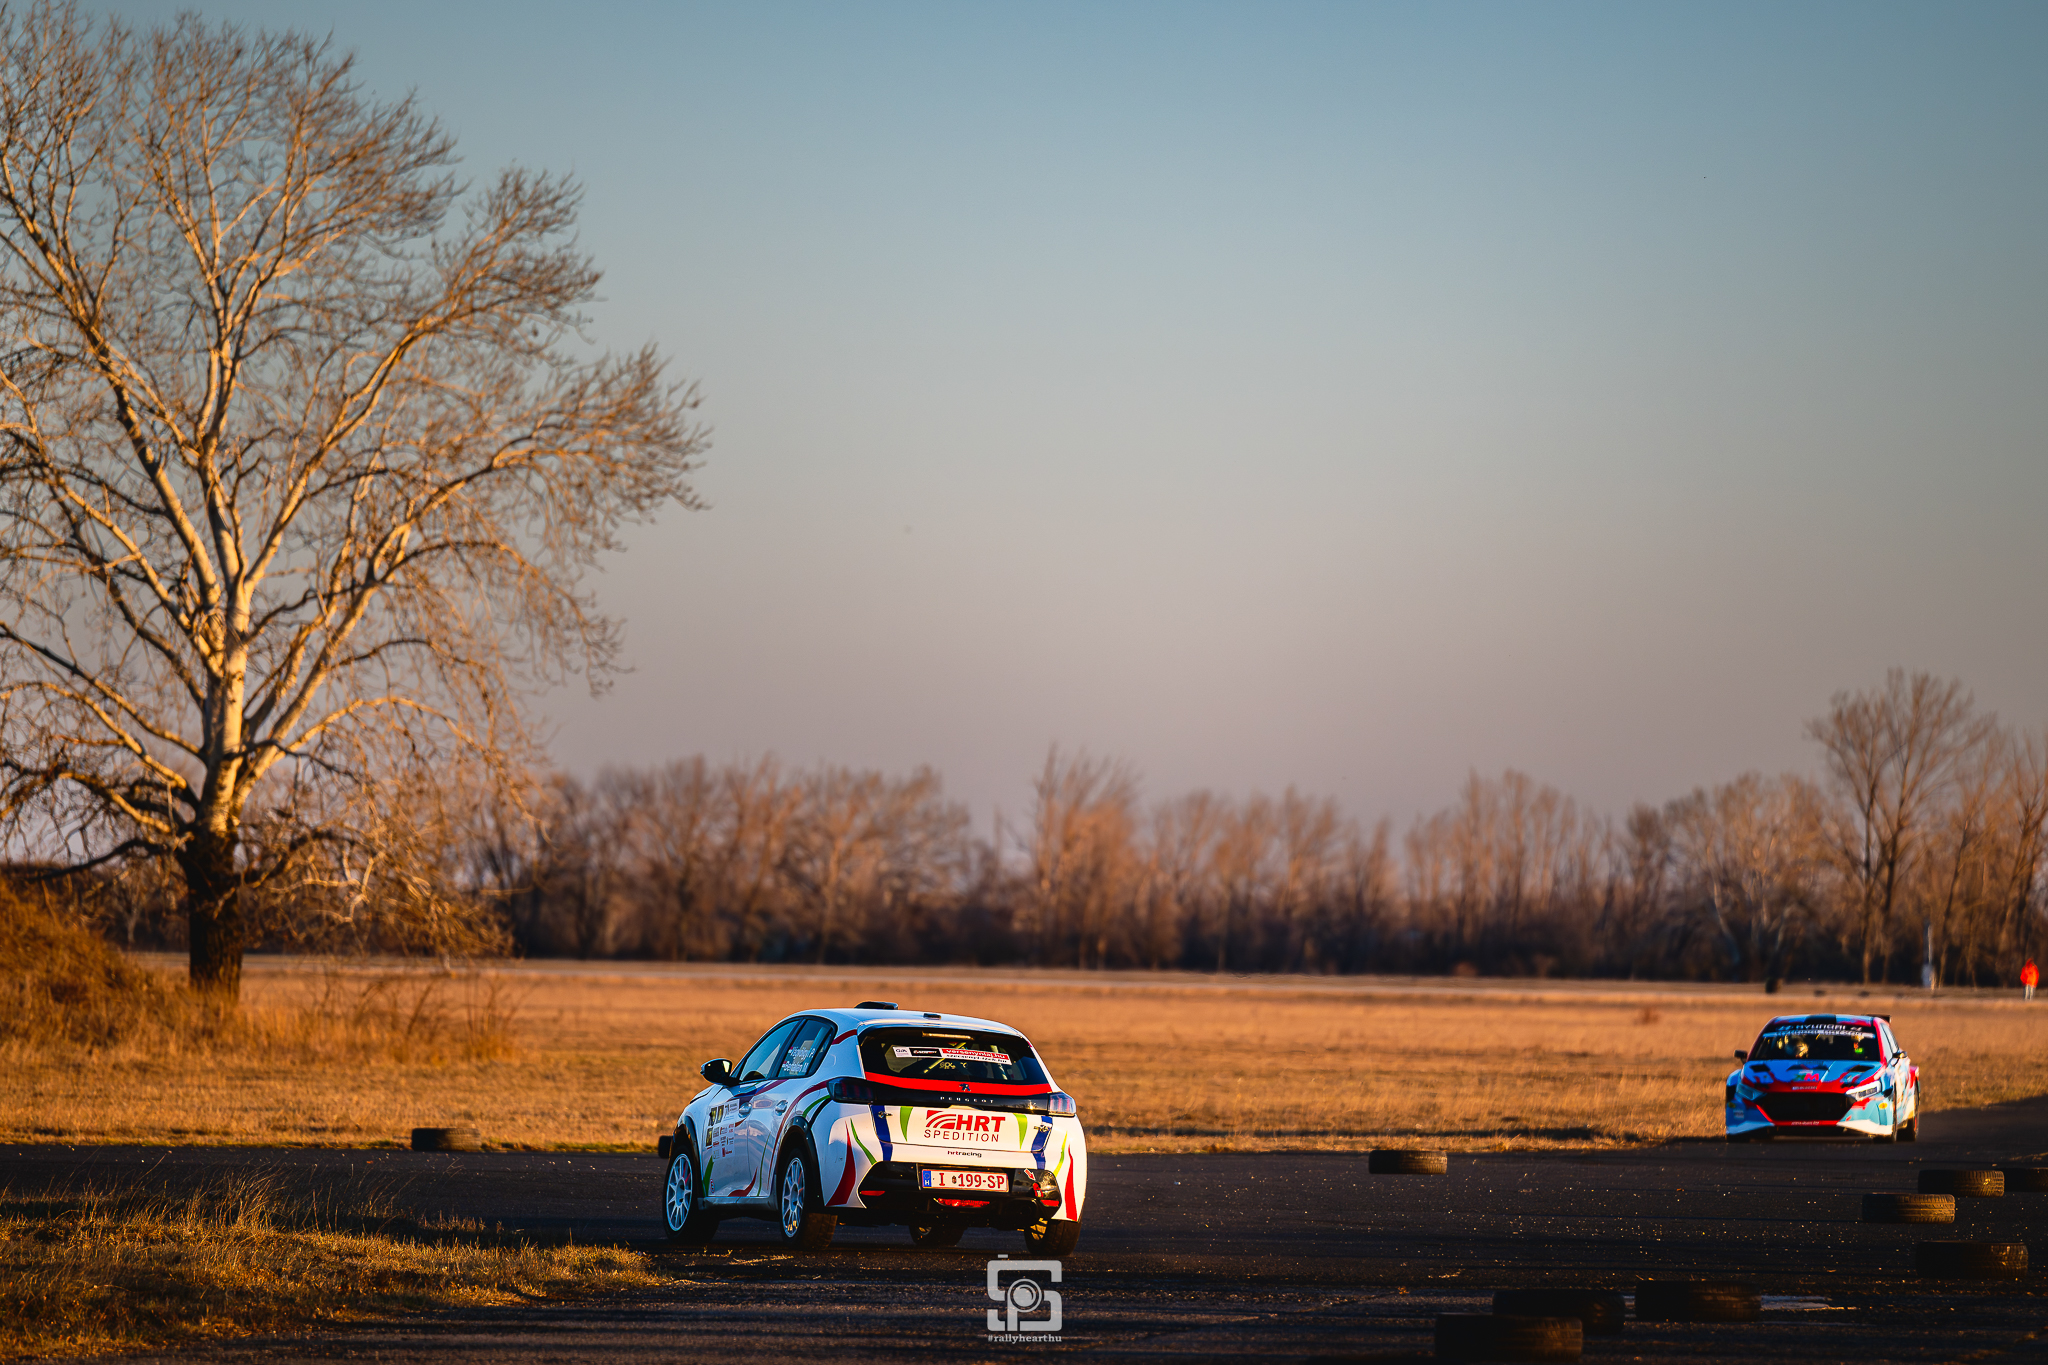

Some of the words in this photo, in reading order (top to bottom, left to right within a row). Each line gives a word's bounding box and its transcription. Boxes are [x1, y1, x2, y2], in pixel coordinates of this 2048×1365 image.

[940, 1096, 994, 1104] PEUGEOT
[955, 1114, 1006, 1133] HRT
[923, 1129, 999, 1143] SPEDITION
[947, 1150, 982, 1158] hrtracing
[957, 1173, 1005, 1189] 199-SP
